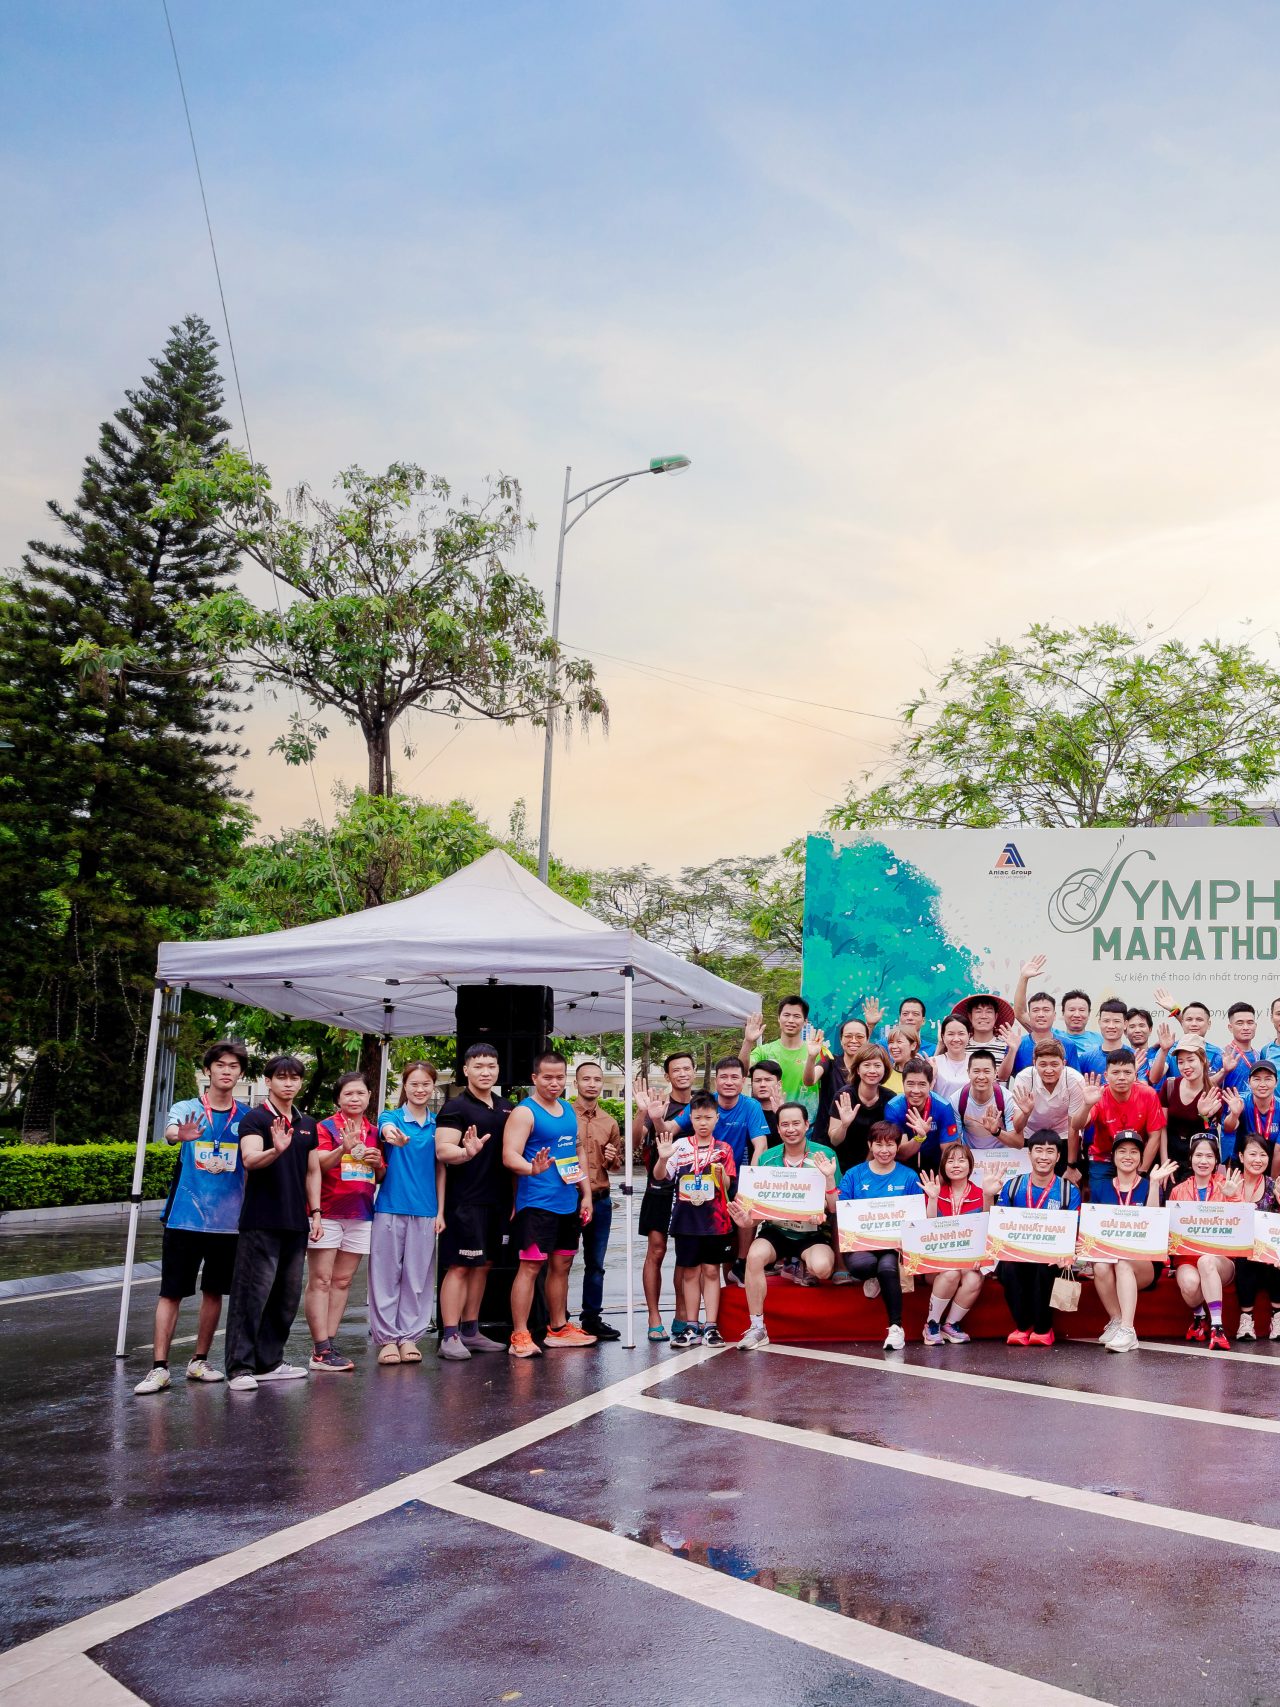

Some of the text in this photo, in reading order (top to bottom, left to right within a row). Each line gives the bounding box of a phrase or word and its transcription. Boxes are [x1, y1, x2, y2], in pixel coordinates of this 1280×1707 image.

[1168, 972, 1190, 981] thao
[1233, 972, 1259, 983] trong
[684, 1183, 709, 1191] 608
[753, 1180, 771, 1190] GIẢI
[790, 1183, 811, 1191] NAM
[758, 1190, 770, 1199] CỰ
[877, 1212, 890, 1220] BA
[1180, 1215, 1197, 1225] GIẢI
[1199, 1215, 1224, 1225] NHẤT
[860, 1222, 873, 1230] CỰ
[999, 1221, 1066, 1233] GIẢI NHẤT NAM
[1100, 1218, 1117, 1228] GIẢI
[1119, 1221, 1132, 1229] BA
[1101, 1229, 1114, 1237] CỰ
[1187, 1226, 1200, 1234] CỰ
[920, 1232, 938, 1242] GIẢI
[1007, 1232, 1020, 1240] CỰ
[925, 1243, 938, 1251] CỰ
